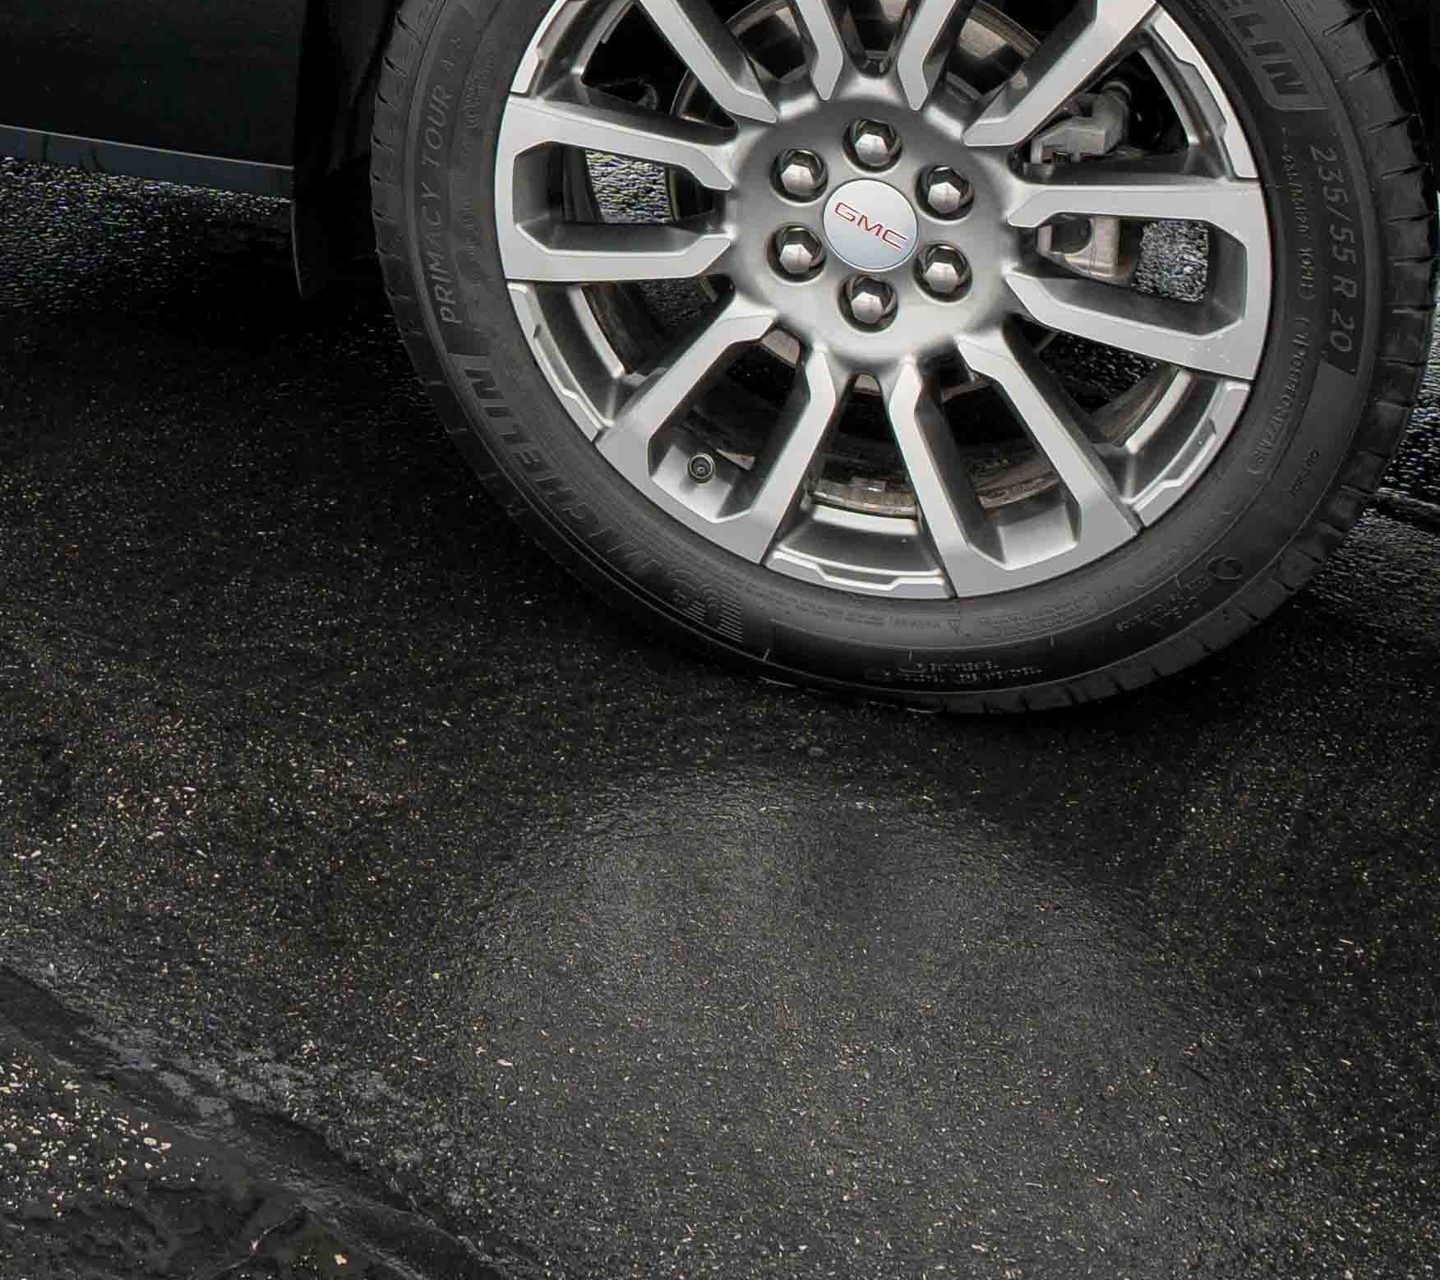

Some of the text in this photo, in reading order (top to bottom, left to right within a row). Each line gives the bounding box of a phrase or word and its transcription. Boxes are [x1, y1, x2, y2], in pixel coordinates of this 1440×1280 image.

[420, 83, 453, 169] TOUR
[420, 181, 463, 326] PRIMACY
[834, 200, 908, 252] GMC
